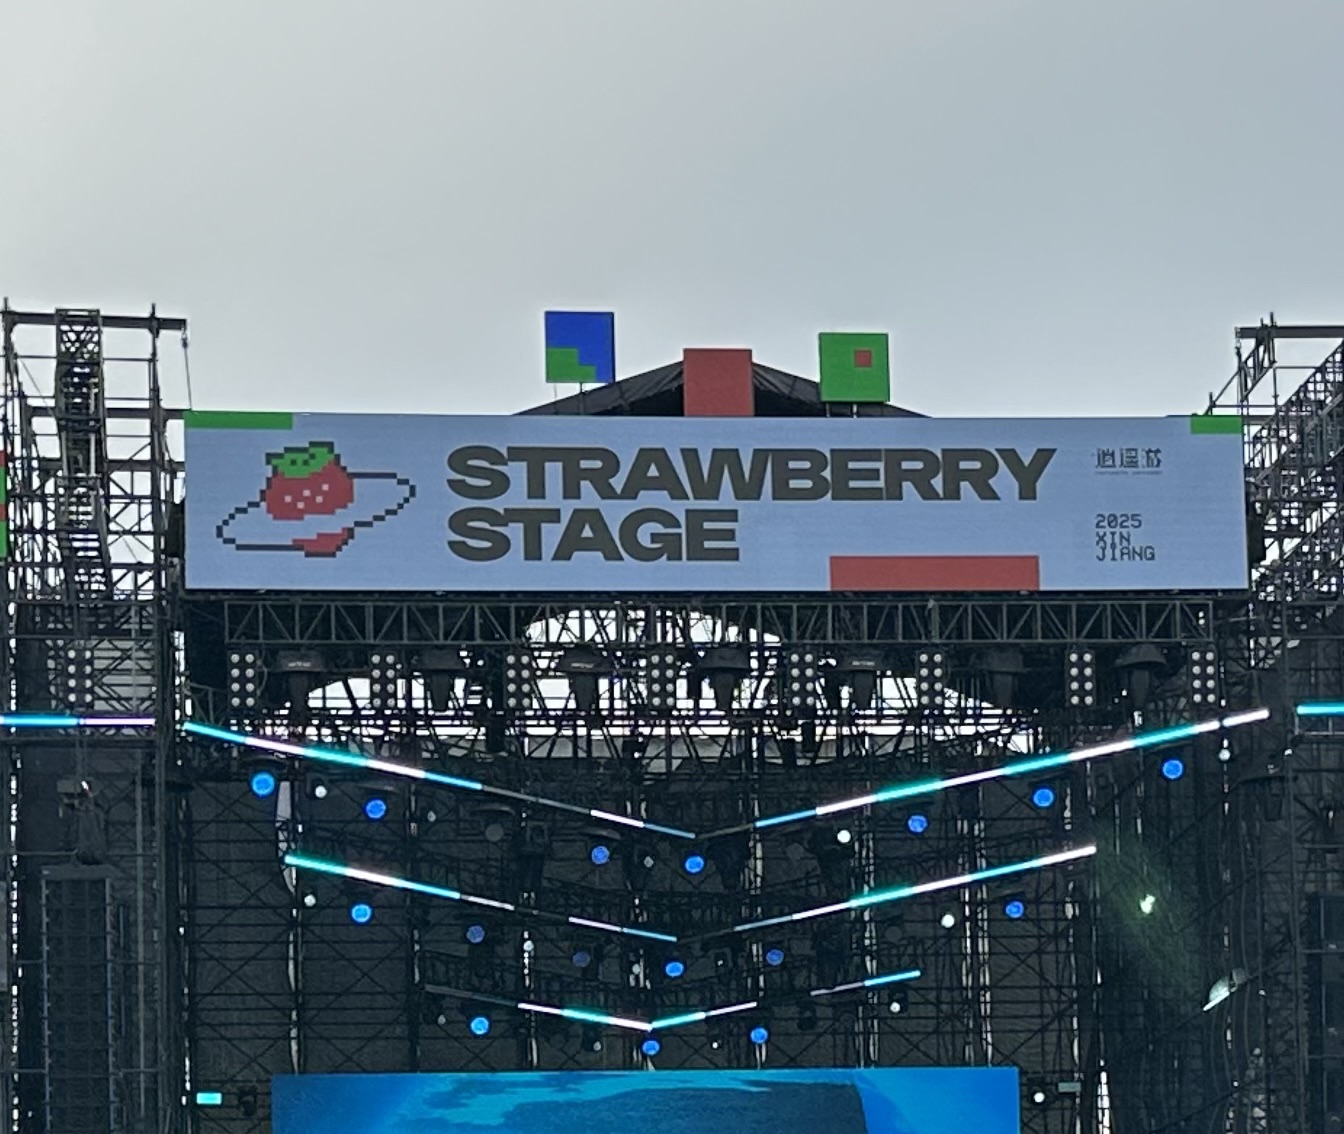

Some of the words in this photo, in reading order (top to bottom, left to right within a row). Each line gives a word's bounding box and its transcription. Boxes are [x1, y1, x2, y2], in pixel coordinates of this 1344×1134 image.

[446, 445, 1058, 501] STRAWBERRY
[1095, 513, 1142, 529] 2025
[447, 506, 740, 562] STAGE
[1095, 531, 1131, 546] XIN
[1095, 544, 1156, 561] JIANG
